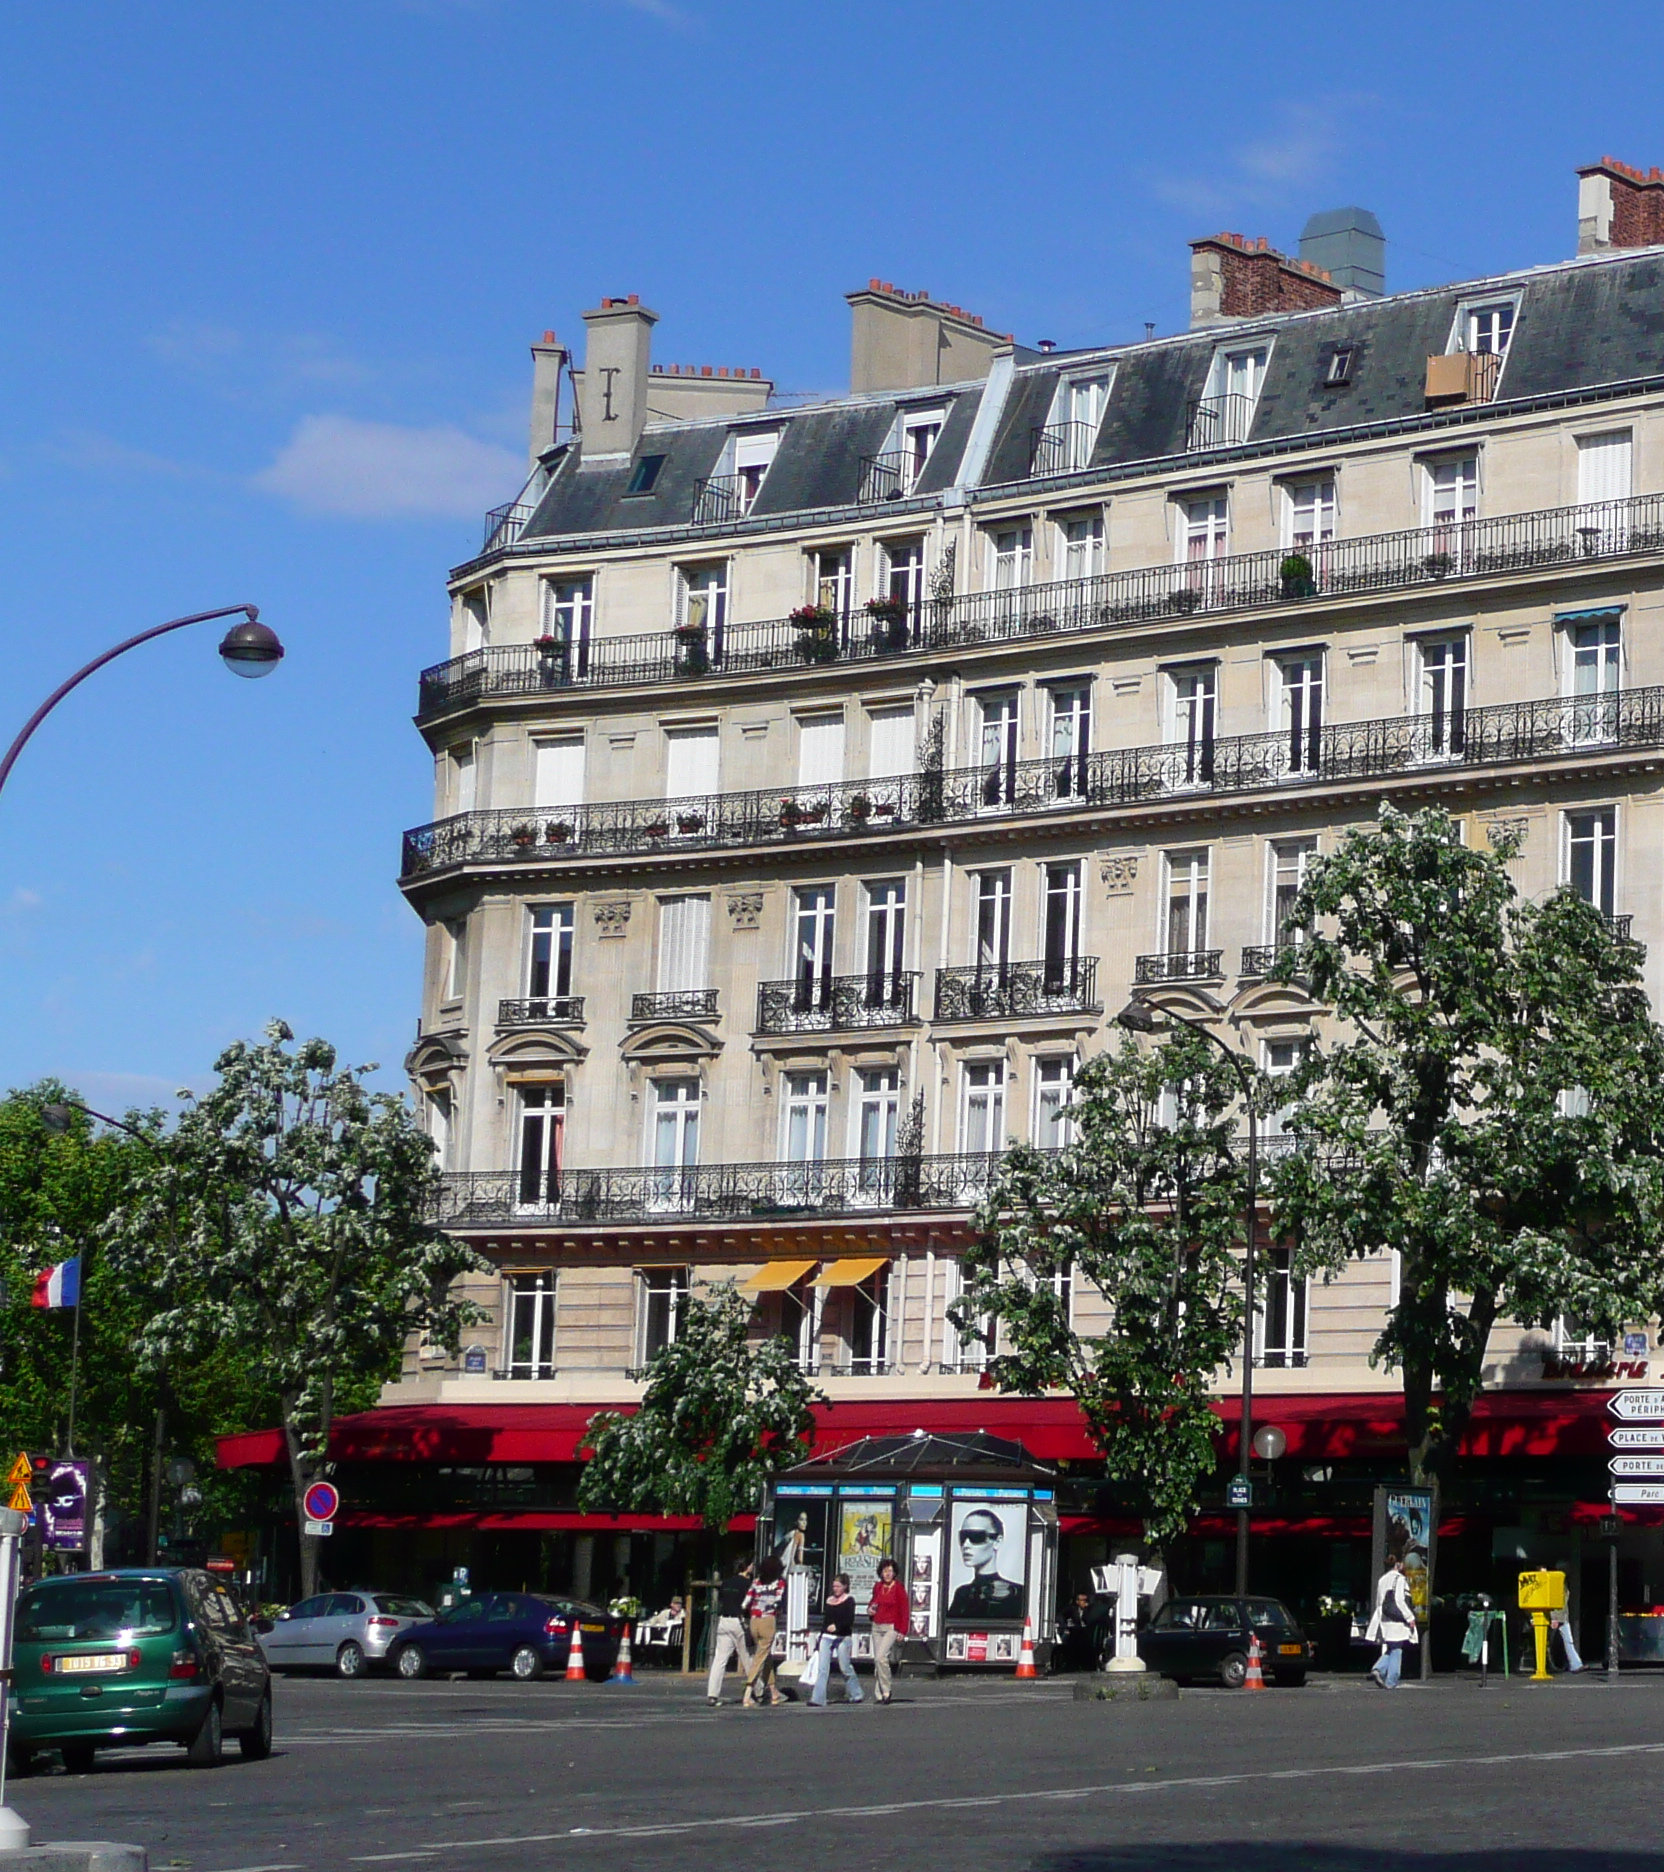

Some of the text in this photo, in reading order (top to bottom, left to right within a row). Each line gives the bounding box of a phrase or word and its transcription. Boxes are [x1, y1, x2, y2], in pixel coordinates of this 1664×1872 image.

[1623, 1394, 1650, 1404] PORTE
[1618, 1433, 1648, 1443] PLACE
[1622, 1461, 1652, 1471] PORTE
[1640, 1489, 1659, 1499] Parc
